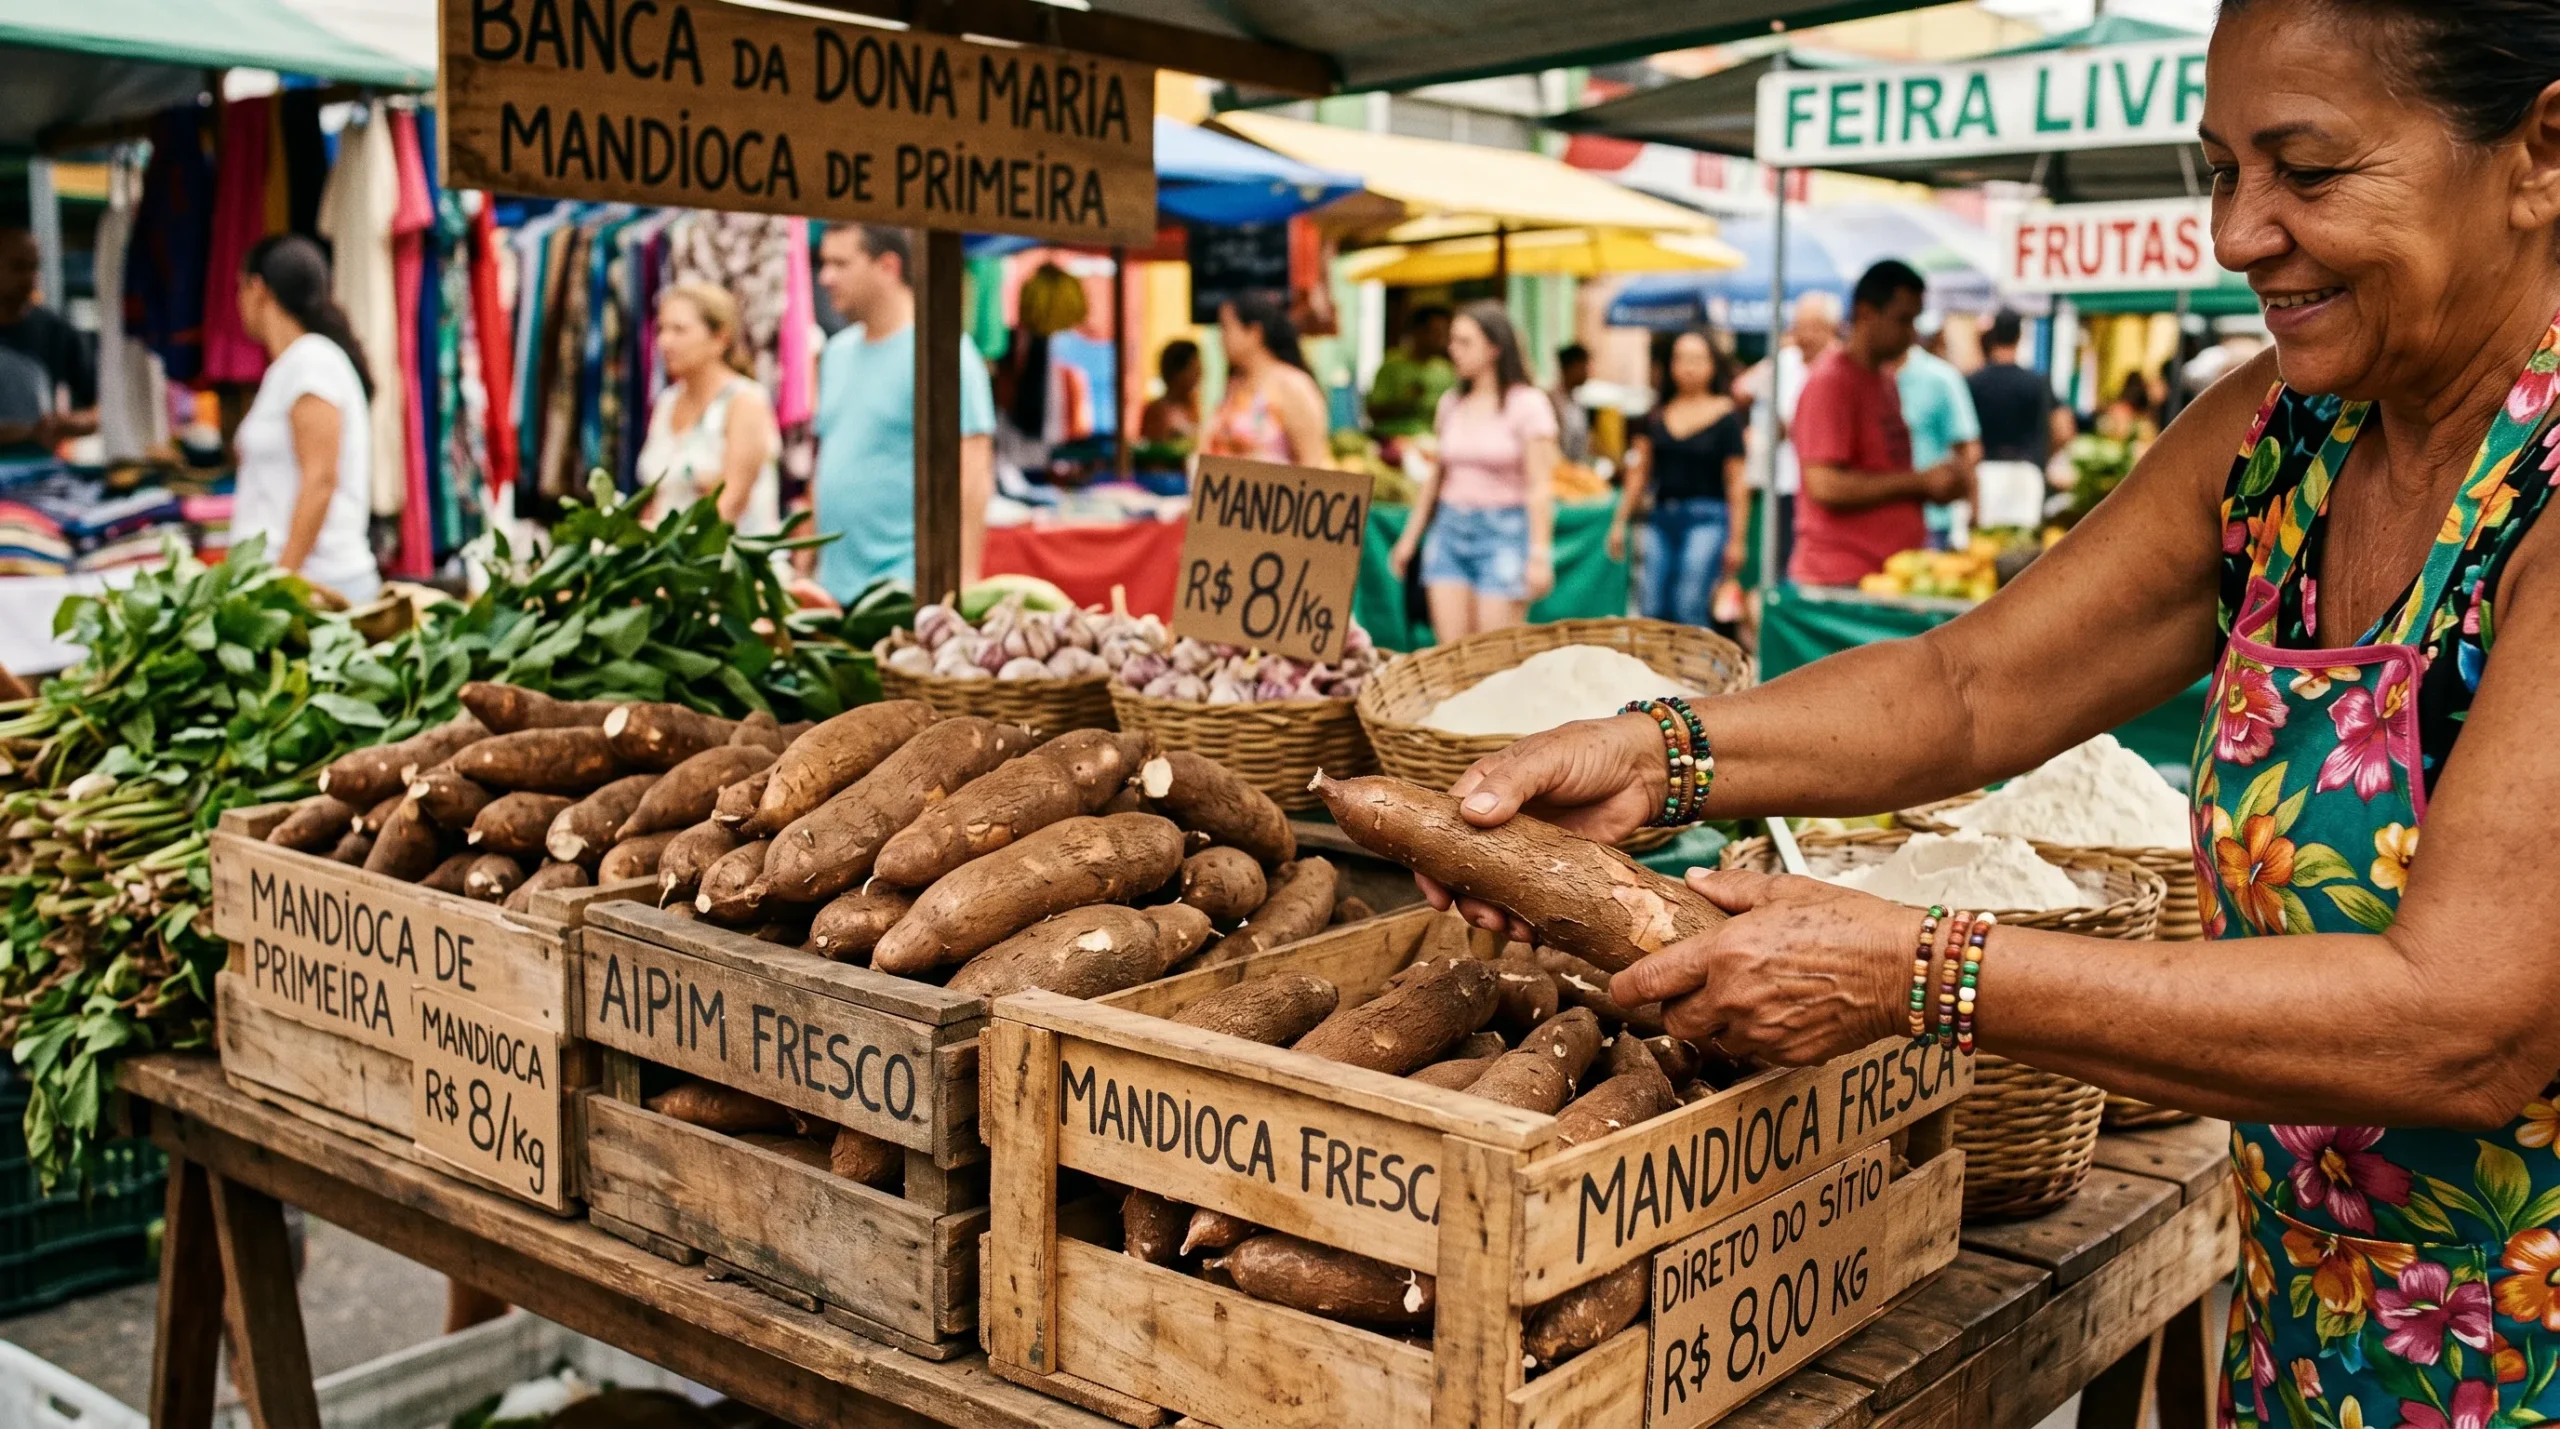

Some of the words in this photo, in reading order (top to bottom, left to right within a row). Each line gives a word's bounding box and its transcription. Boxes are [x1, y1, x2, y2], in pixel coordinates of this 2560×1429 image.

[471, 0, 705, 85] BANCA
[732, 39, 789, 94] DA
[815, 27, 957, 117] DONA
[978, 56, 1131, 143] MARIA
[1786, 72, 1998, 149] FEIRA
[2035, 55, 2206, 132] LIVR
[501, 102, 800, 199] MANDIOCA
[826, 150, 874, 200] DE
[896, 141, 1109, 228] PRIMEIRA
[2014, 217, 2200, 279] FRUTAS
[1197, 472, 1360, 546] MANDIOCA
[1185, 560, 1233, 615] R$
[251, 868, 418, 974] MANDIOCA
[435, 925, 476, 992] DE
[254, 938, 394, 1037] PRIMEIRA
[422, 1001, 545, 1089] MANDIOCA
[425, 1069, 459, 1126] R$
[600, 953, 727, 1062] AIPIM
[752, 1005, 915, 1121] FRESCO
[1061, 1060, 1275, 1183] MANDIOCA
[1300, 1126, 1439, 1225] FRESC
[1577, 1085, 1820, 1264] MANDIOCA
[1837, 1041, 1955, 1144] FRESCA
[1662, 1223, 1758, 1315] DIRETO
[1772, 1200, 1806, 1254] DO
[1819, 1158, 1882, 1228] SÍTIO
[1663, 1324, 1711, 1415] R$
[1726, 1258, 1819, 1382] 8,00
[1831, 1246, 1868, 1316] KG
